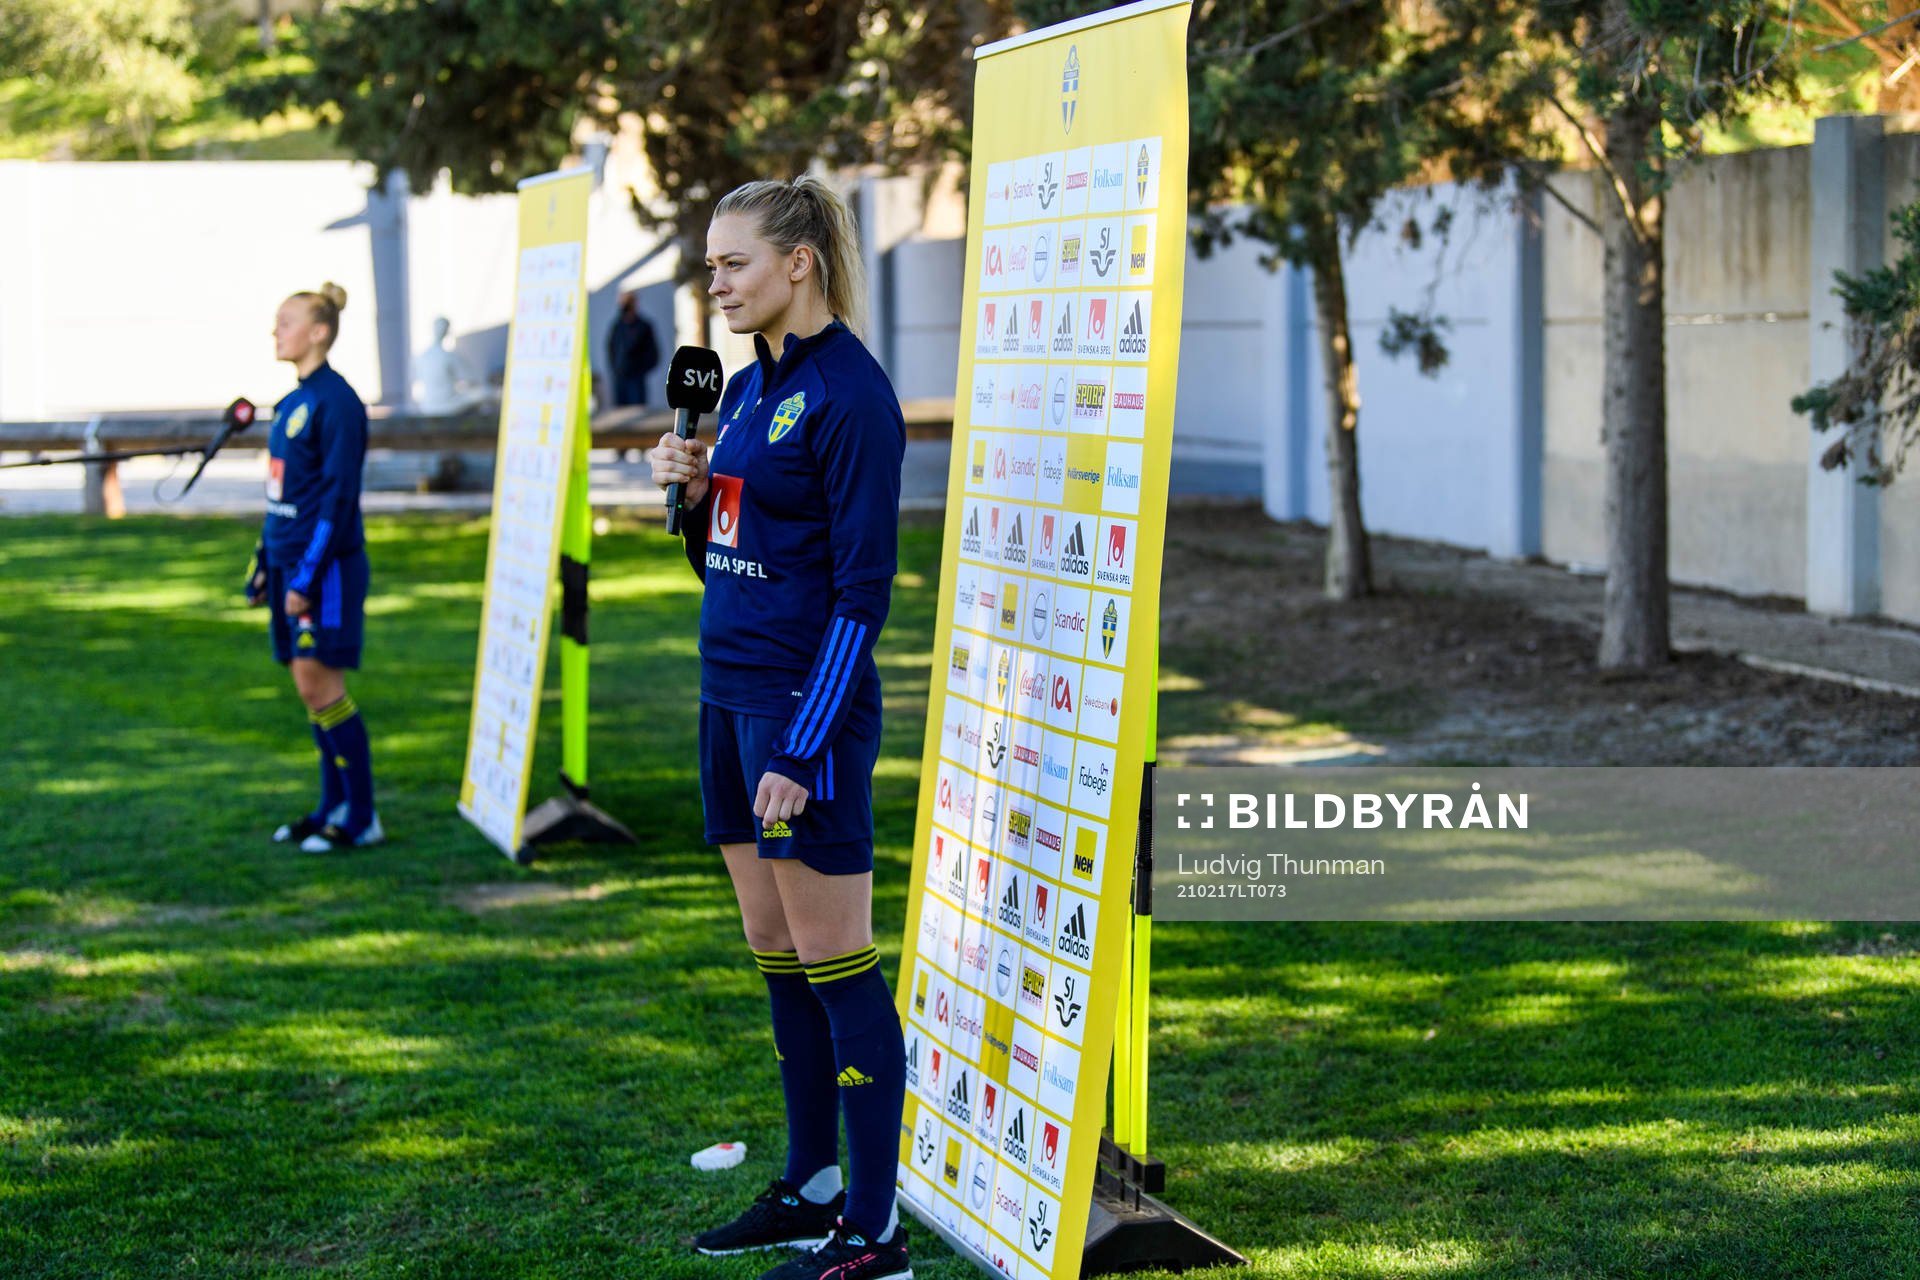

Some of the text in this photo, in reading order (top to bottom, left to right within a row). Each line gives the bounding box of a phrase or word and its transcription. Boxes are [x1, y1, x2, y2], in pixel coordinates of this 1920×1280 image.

[1044, 161, 1053, 185] SJ
[1093, 168, 1123, 189] Folksam
[1099, 227, 1111, 251] SJ
[985, 244, 1003, 276] ICA
[1053, 336, 1073, 353] adidas
[1077, 344, 1111, 356] SVENSKA SPEL
[1120, 335, 1146, 354] adidas
[683, 368, 719, 392] svt
[1076, 384, 1105, 410] SPORT
[1114, 393, 1144, 410] BAUHAUS
[1011, 456, 1036, 478] Scandic
[1107, 465, 1139, 489] Folksam
[1004, 544, 1027, 565] adidas
[1060, 554, 1089, 576] adidas
[732, 557, 768, 580] SPEL
[1096, 569, 1131, 586] SVENSKA SPEL
[1054, 608, 1086, 633] Scandic
[1050, 674, 1073, 714] ICA
[993, 721, 1002, 745] SJ
[1042, 754, 1068, 781] Folksam
[1078, 765, 1108, 797] Fabege
[763, 828, 793, 839] adidas
[998, 905, 1021, 930] adidas
[1058, 933, 1090, 961] adidas
[1063, 976, 1076, 1002] SJ
[1042, 1060, 1075, 1096] Folksam
[1003, 1136, 1028, 1166] adidas
[1031, 1163, 1061, 1191] SVENSKA SPEL
[1036, 1200, 1048, 1226] SJ
